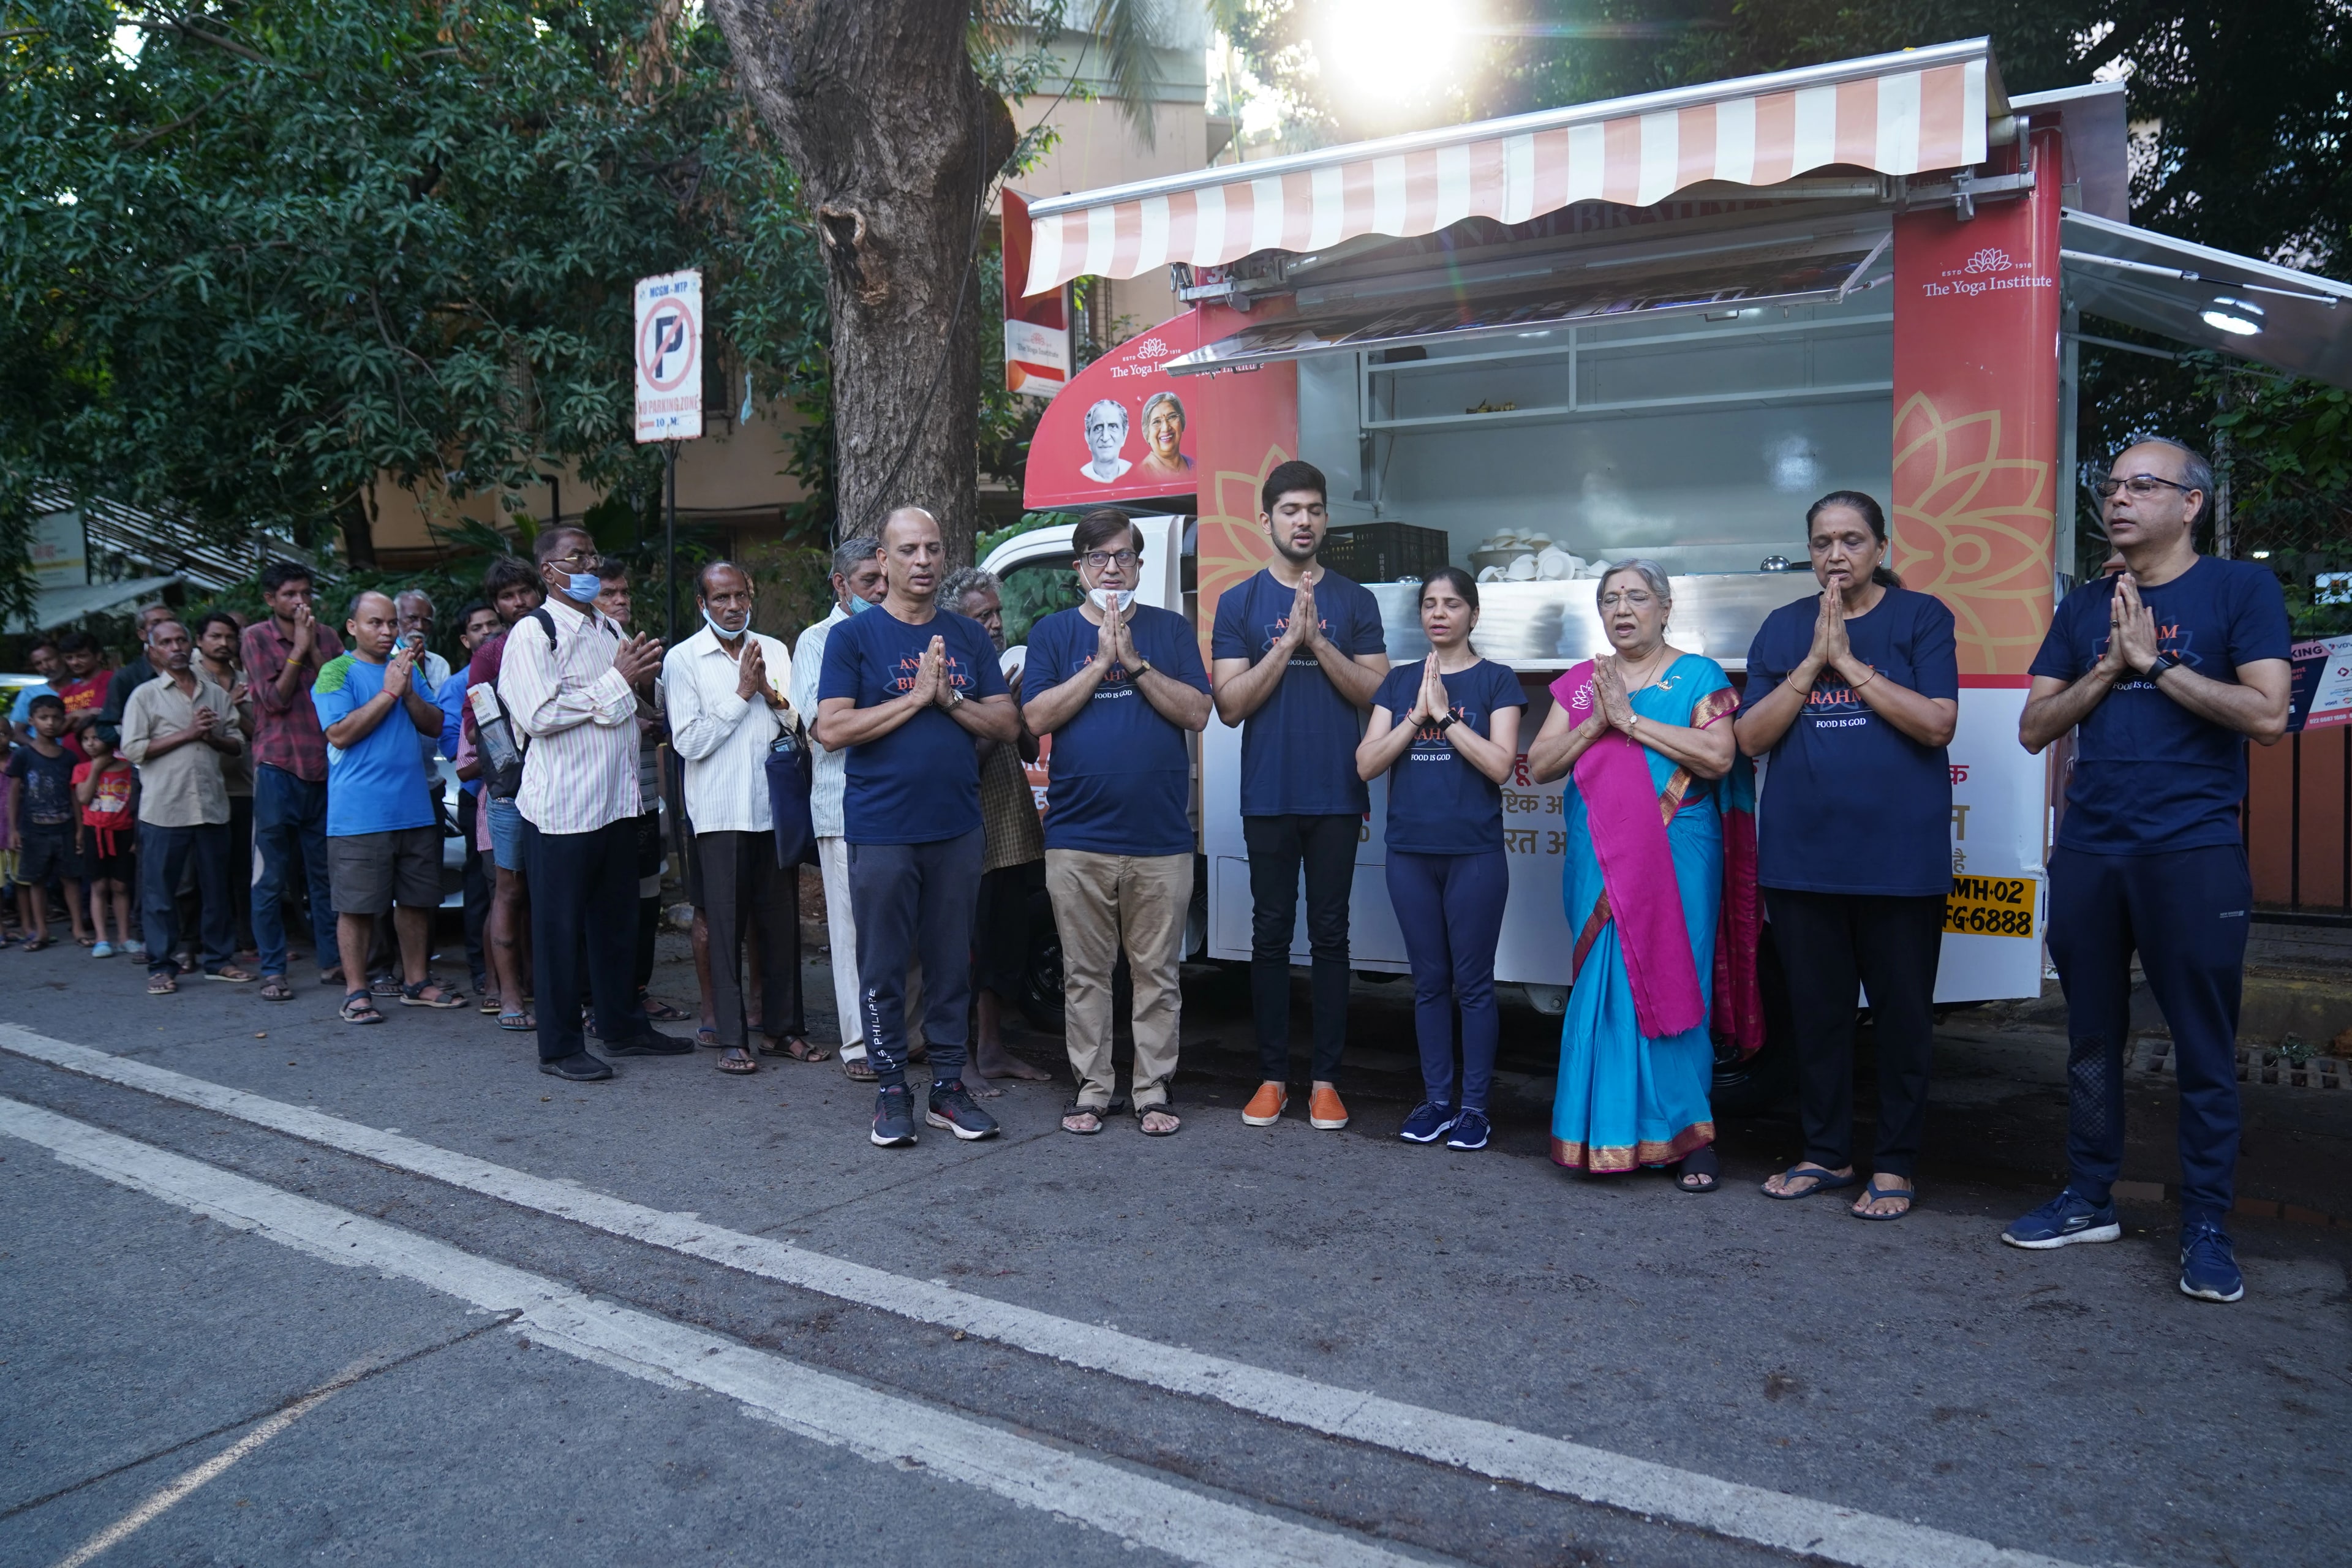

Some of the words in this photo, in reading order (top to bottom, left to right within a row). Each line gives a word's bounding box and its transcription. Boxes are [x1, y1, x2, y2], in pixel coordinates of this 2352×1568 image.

[650, 284, 669, 298] MCGM
[674, 282, 688, 293] MTP
[1923, 283, 1950, 296] The
[1951, 280, 1986, 296] Yoga
[1989, 275, 2052, 290] Institute
[1016, 343, 1027, 352] The
[1026, 344, 1038, 355] Yoga
[1110, 366, 1129, 378] The
[1129, 364, 1152, 377] Yoga
[648, 398, 679, 415] PARKING
[680, 396, 698, 410] ZONE
[655, 418, 665, 428] 10
[1816, 720, 1838, 728] FOOD
[1839, 719, 1847, 728] IS
[1848, 717, 1866, 726] GOD
[868, 988, 882, 1045] PHILIPPE
